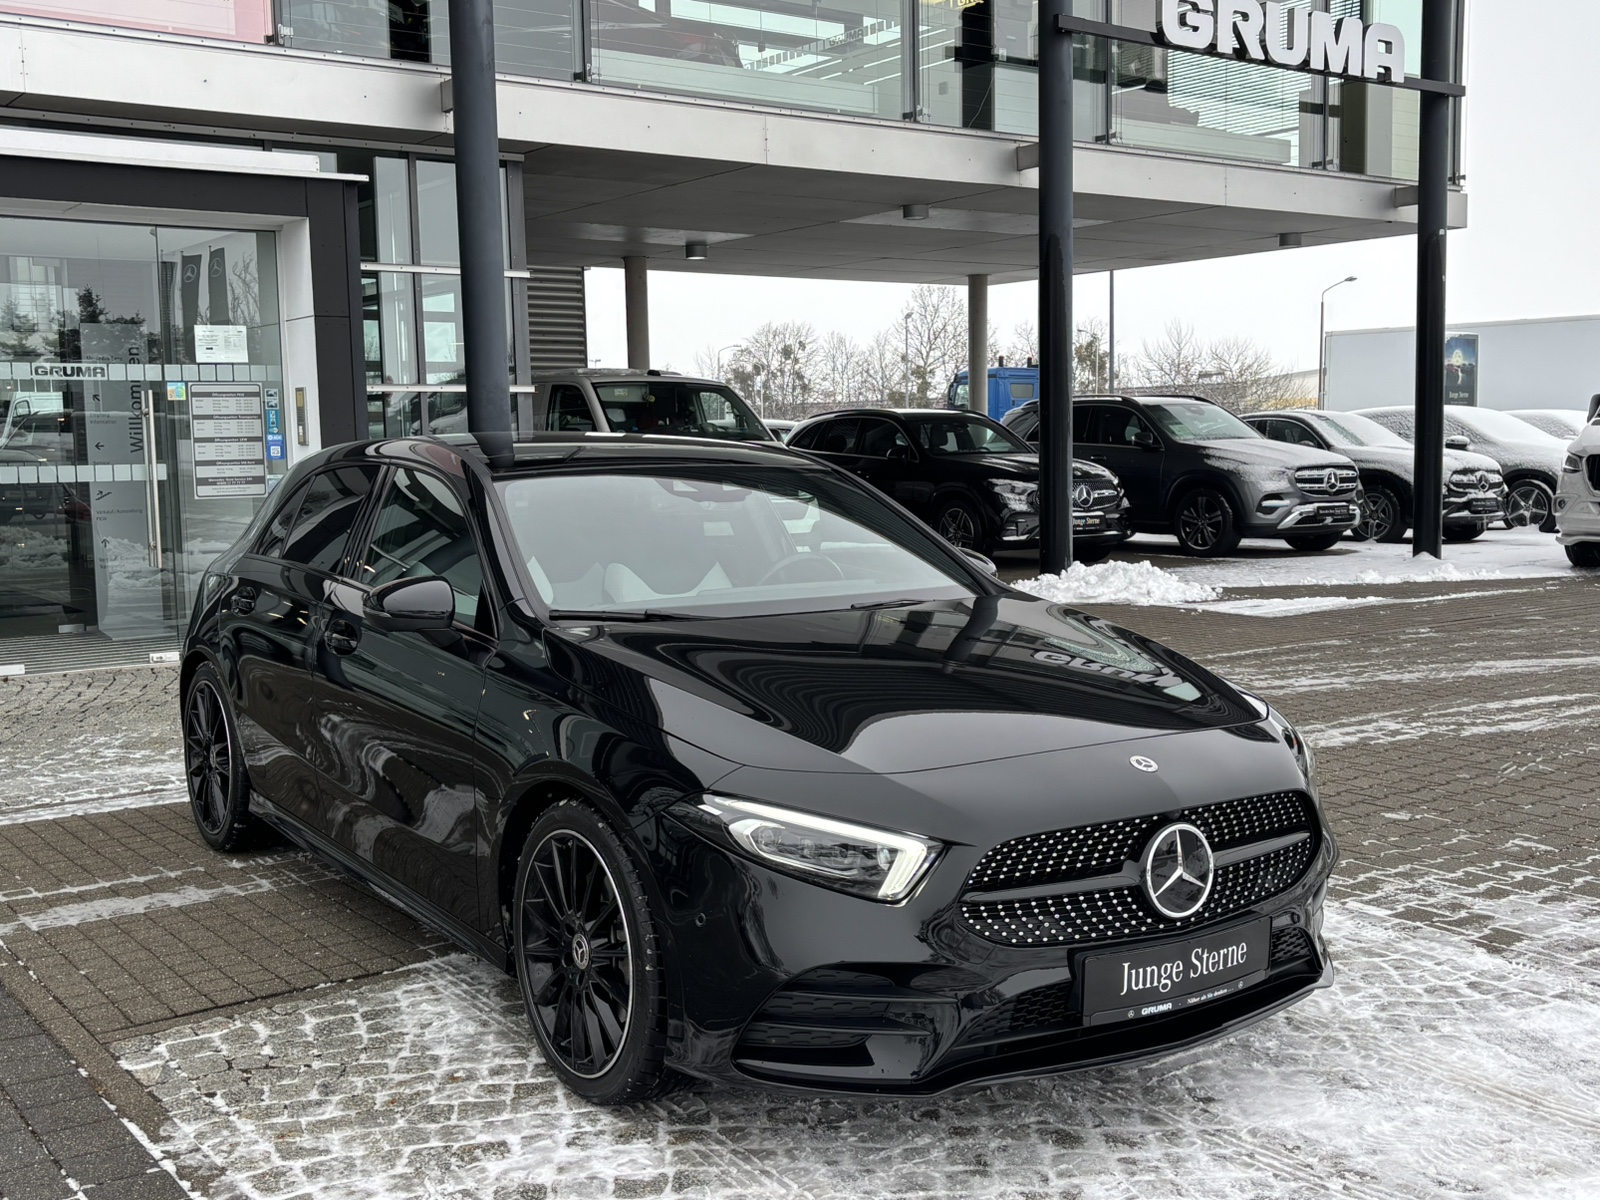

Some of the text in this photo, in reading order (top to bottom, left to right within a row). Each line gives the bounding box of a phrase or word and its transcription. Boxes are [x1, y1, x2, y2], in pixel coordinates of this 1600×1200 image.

[828, 27, 864, 48] GRUMA
[1161, 0, 1405, 84] GRUMA
[34, 365, 106, 378] GRUMA
[128, 346, 144, 453] Willkomen
[1120, 942, 1247, 995] Junge Sterne
[1141, 1002, 1173, 1015] GRUMA
